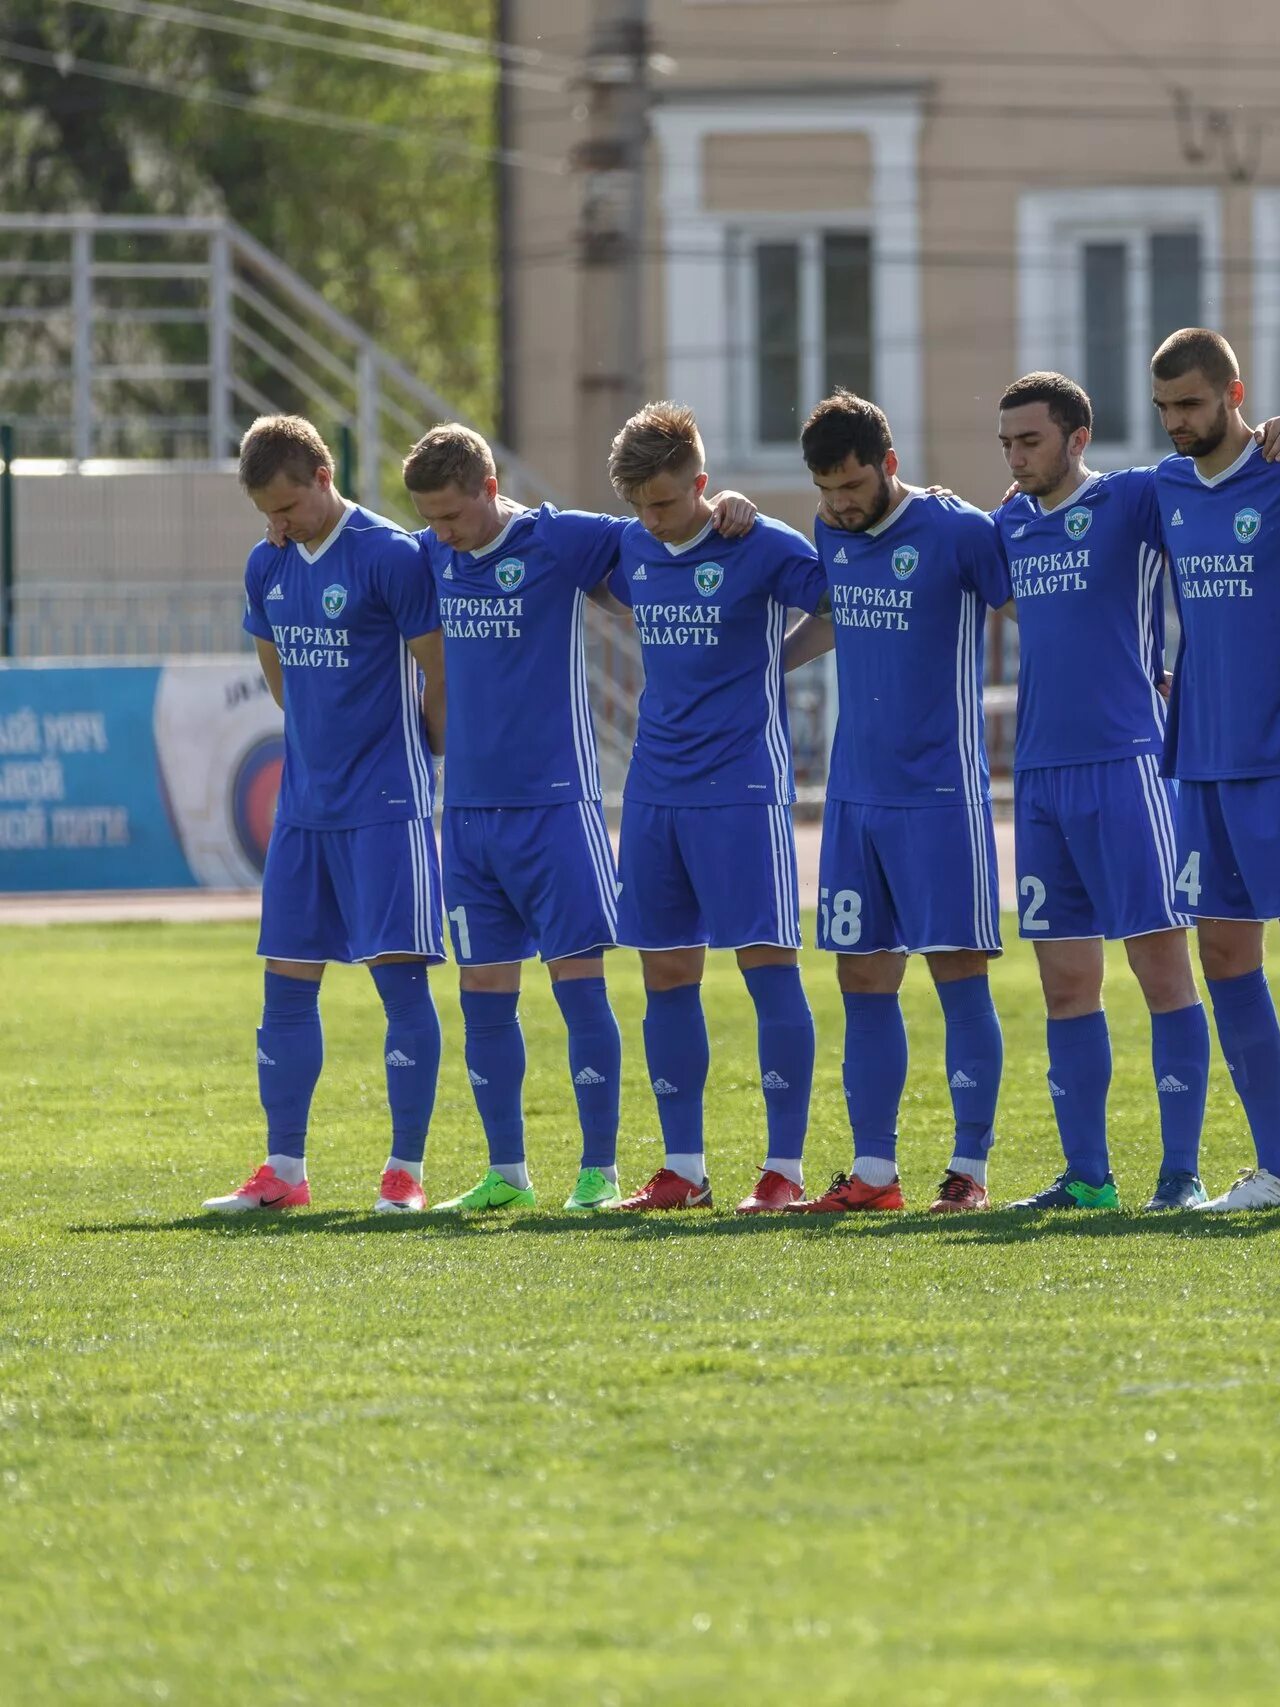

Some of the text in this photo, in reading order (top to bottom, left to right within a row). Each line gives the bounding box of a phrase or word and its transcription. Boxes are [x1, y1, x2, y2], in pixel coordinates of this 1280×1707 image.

[1010, 549, 1091, 581] КУРСКАЯ
[833, 584, 914, 609] КУРСКАЯ
[834, 607, 909, 631] ОБЛАСТЬ
[1175, 850, 1202, 907] 4
[1019, 875, 1050, 931] 2
